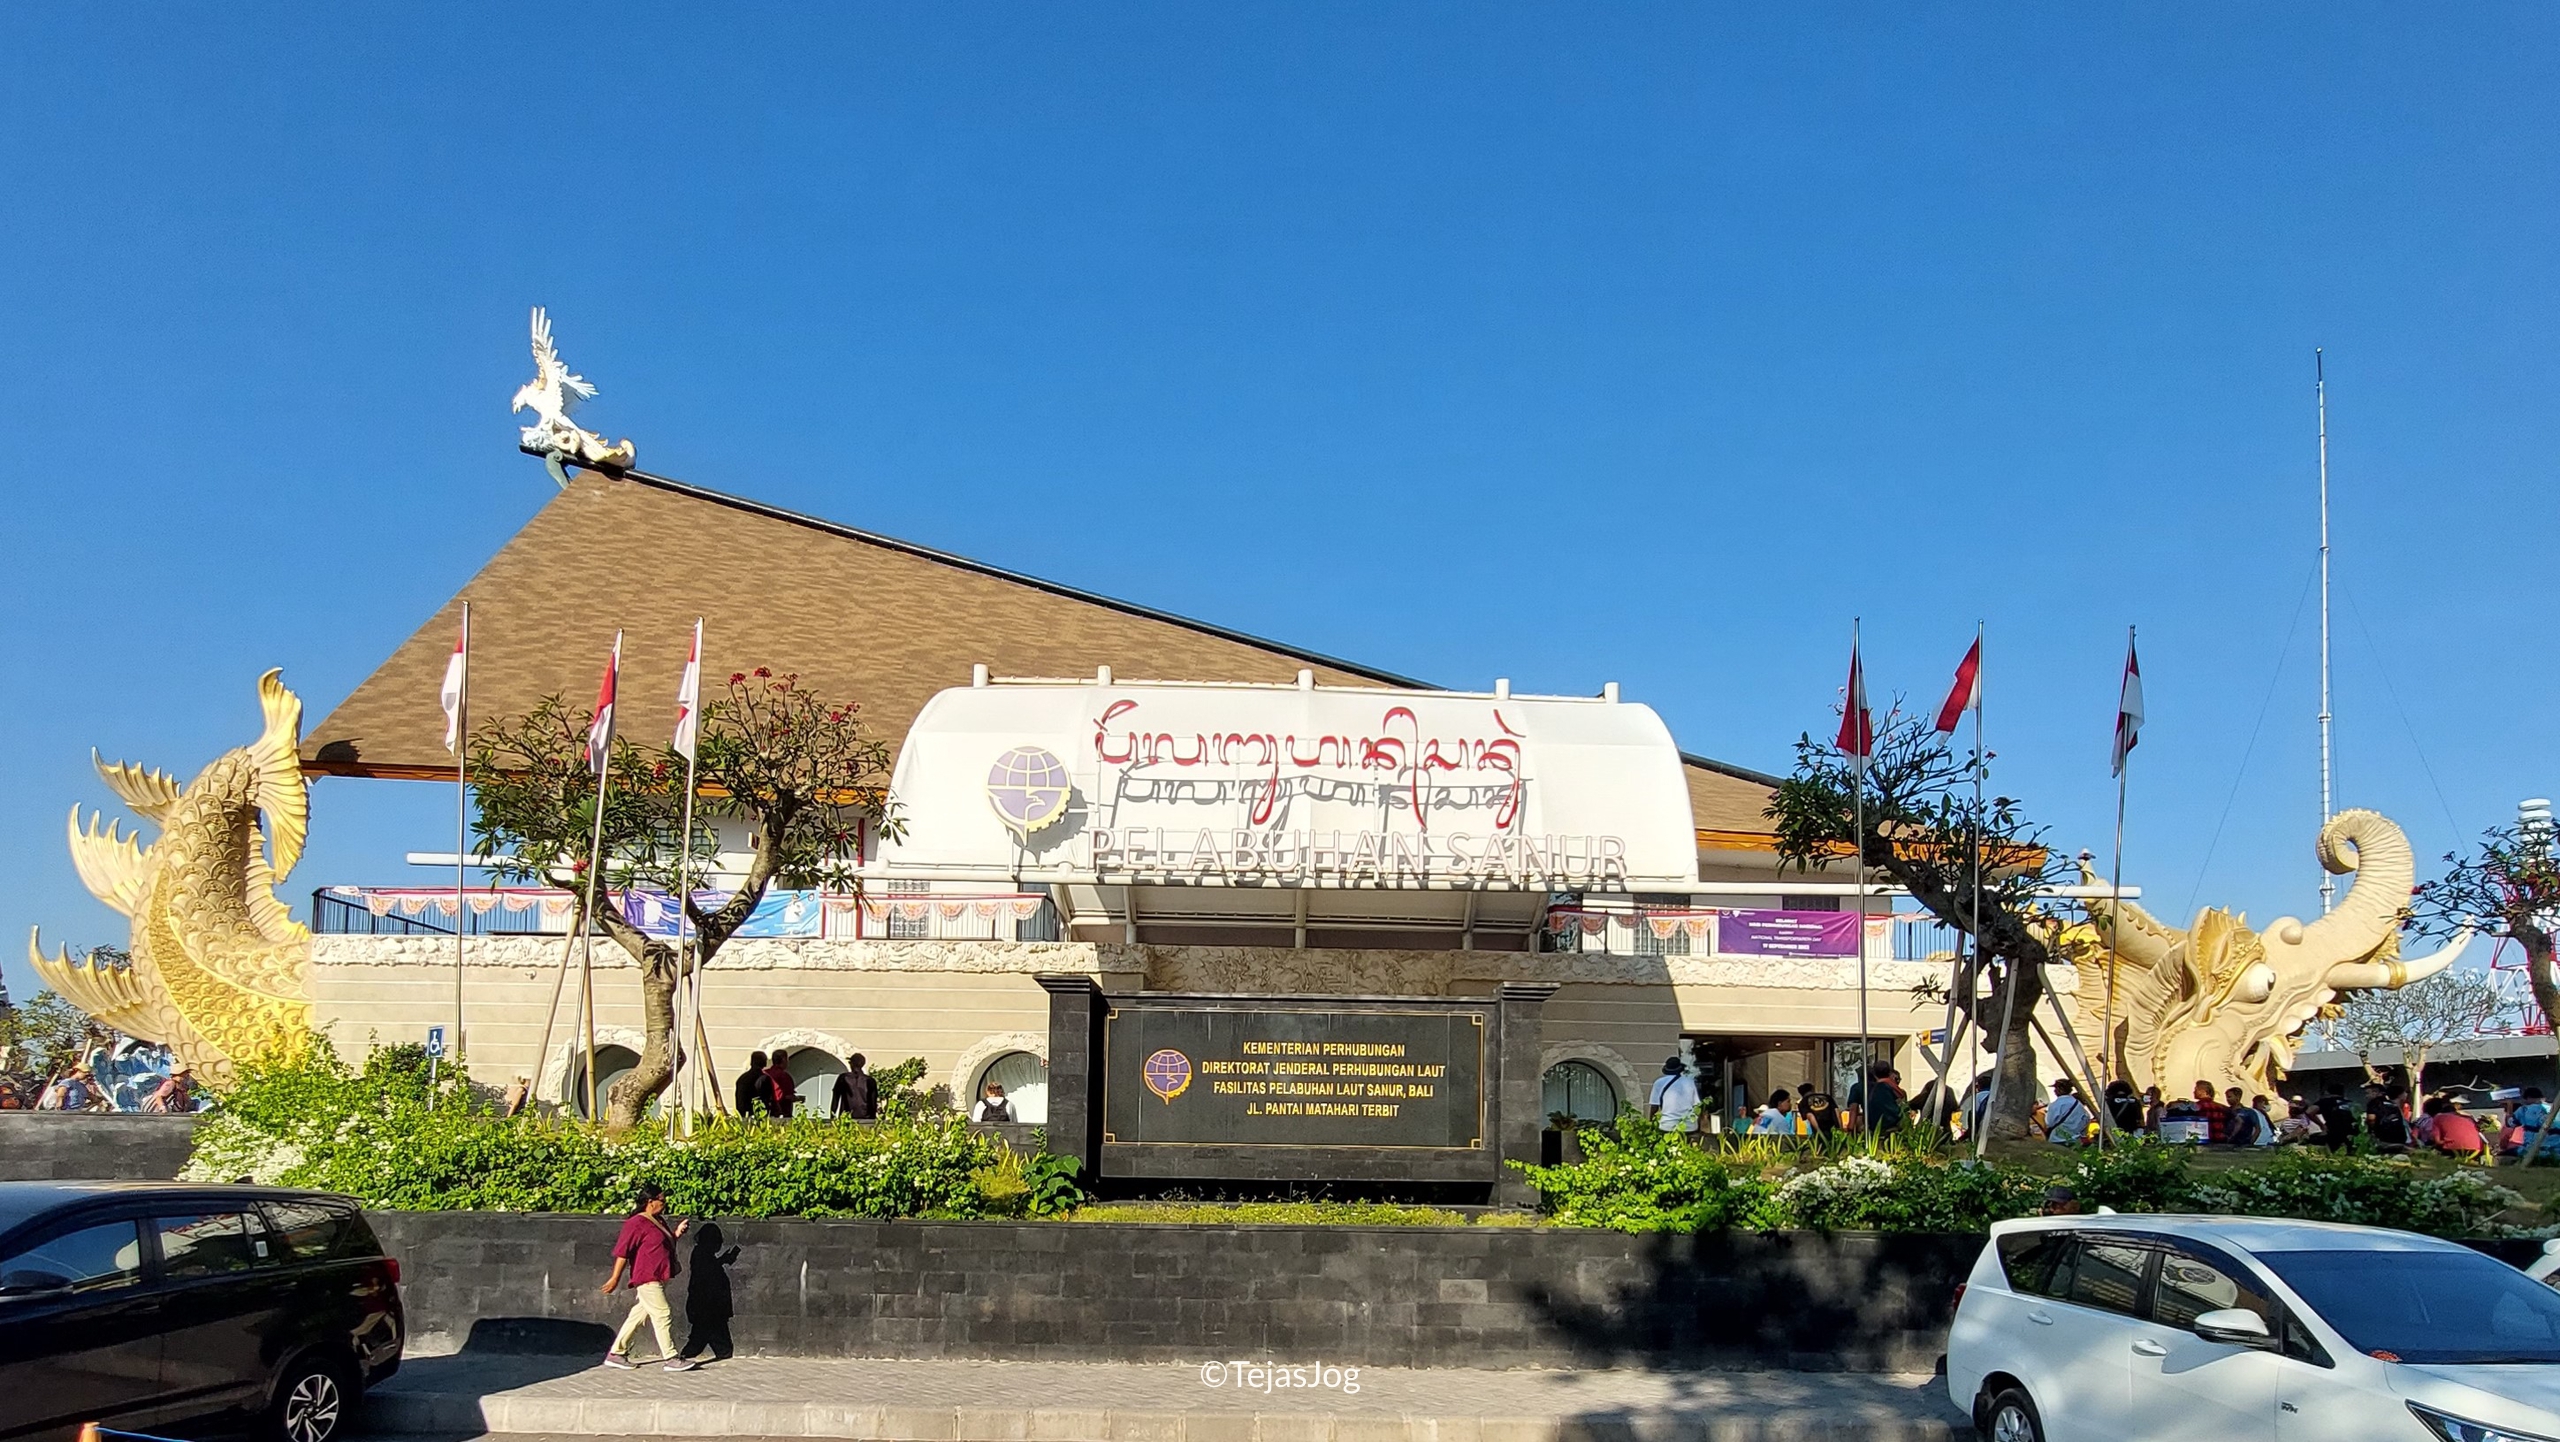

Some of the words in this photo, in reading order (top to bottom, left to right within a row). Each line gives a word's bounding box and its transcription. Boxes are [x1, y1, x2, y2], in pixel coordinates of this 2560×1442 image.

[1086, 826, 1425, 873] PELABUHAN
[1445, 831, 1628, 879] SANUR
[1243, 1041, 1320, 1055] KEMENTERIAN
[1323, 1043, 1405, 1057] PERHUBUNGAN
[1201, 1061, 1270, 1075] DIREKTORAT
[1272, 1062, 1330, 1076] JENDERAL
[1332, 1063, 1415, 1077] PERHUBUNGAN
[1417, 1065, 1446, 1078] LAUT
[1213, 1081, 1266, 1094] FASILITAS
[1269, 1082, 1334, 1096] PELABUHAN
[1336, 1083, 1364, 1096] LAUT
[1366, 1084, 1407, 1099] SANUR,
[1408, 1085, 1434, 1097] BALI
[1246, 1102, 1263, 1115] JL.
[1265, 1103, 1303, 1115] PANTAI
[1305, 1103, 1359, 1116] MATAHARI
[1361, 1104, 1400, 1117] TERBIT
